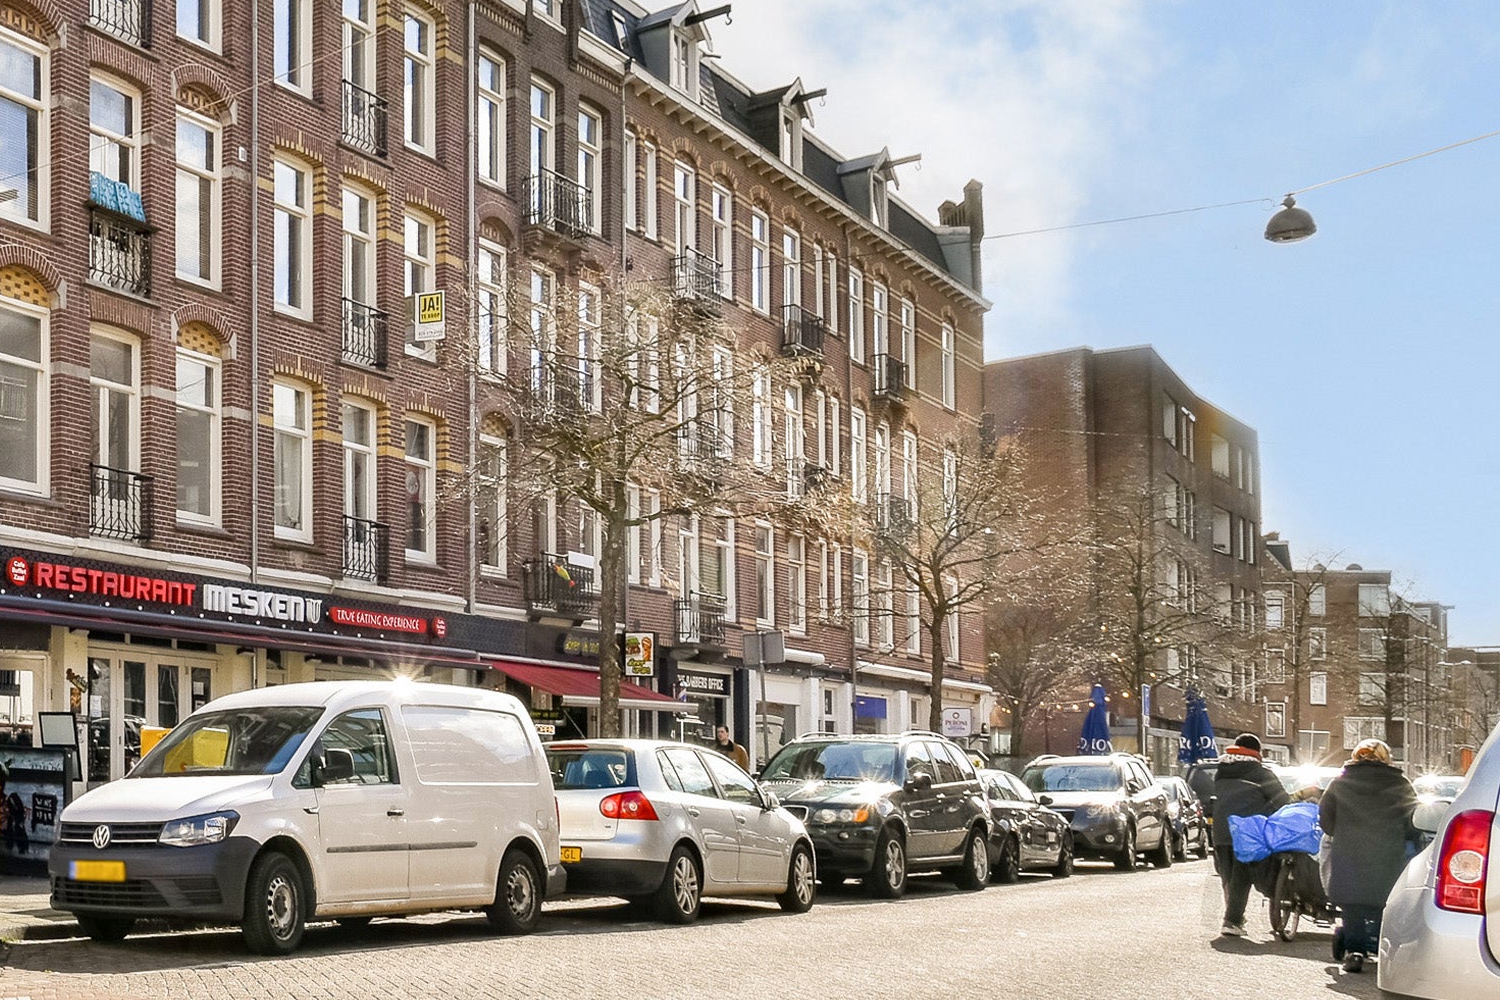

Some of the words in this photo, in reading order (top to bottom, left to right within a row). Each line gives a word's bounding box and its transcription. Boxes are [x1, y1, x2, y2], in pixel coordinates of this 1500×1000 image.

[421, 296, 439, 313] JA!
[35, 562, 197, 606] RESTAURANT
[203, 583, 305, 623] MESKEN
[336, 609, 355, 623] TRUE
[356, 610, 382, 626] EATING
[383, 613, 420, 631] EXPERIENCE
[708, 678, 724, 691] OFFICE
